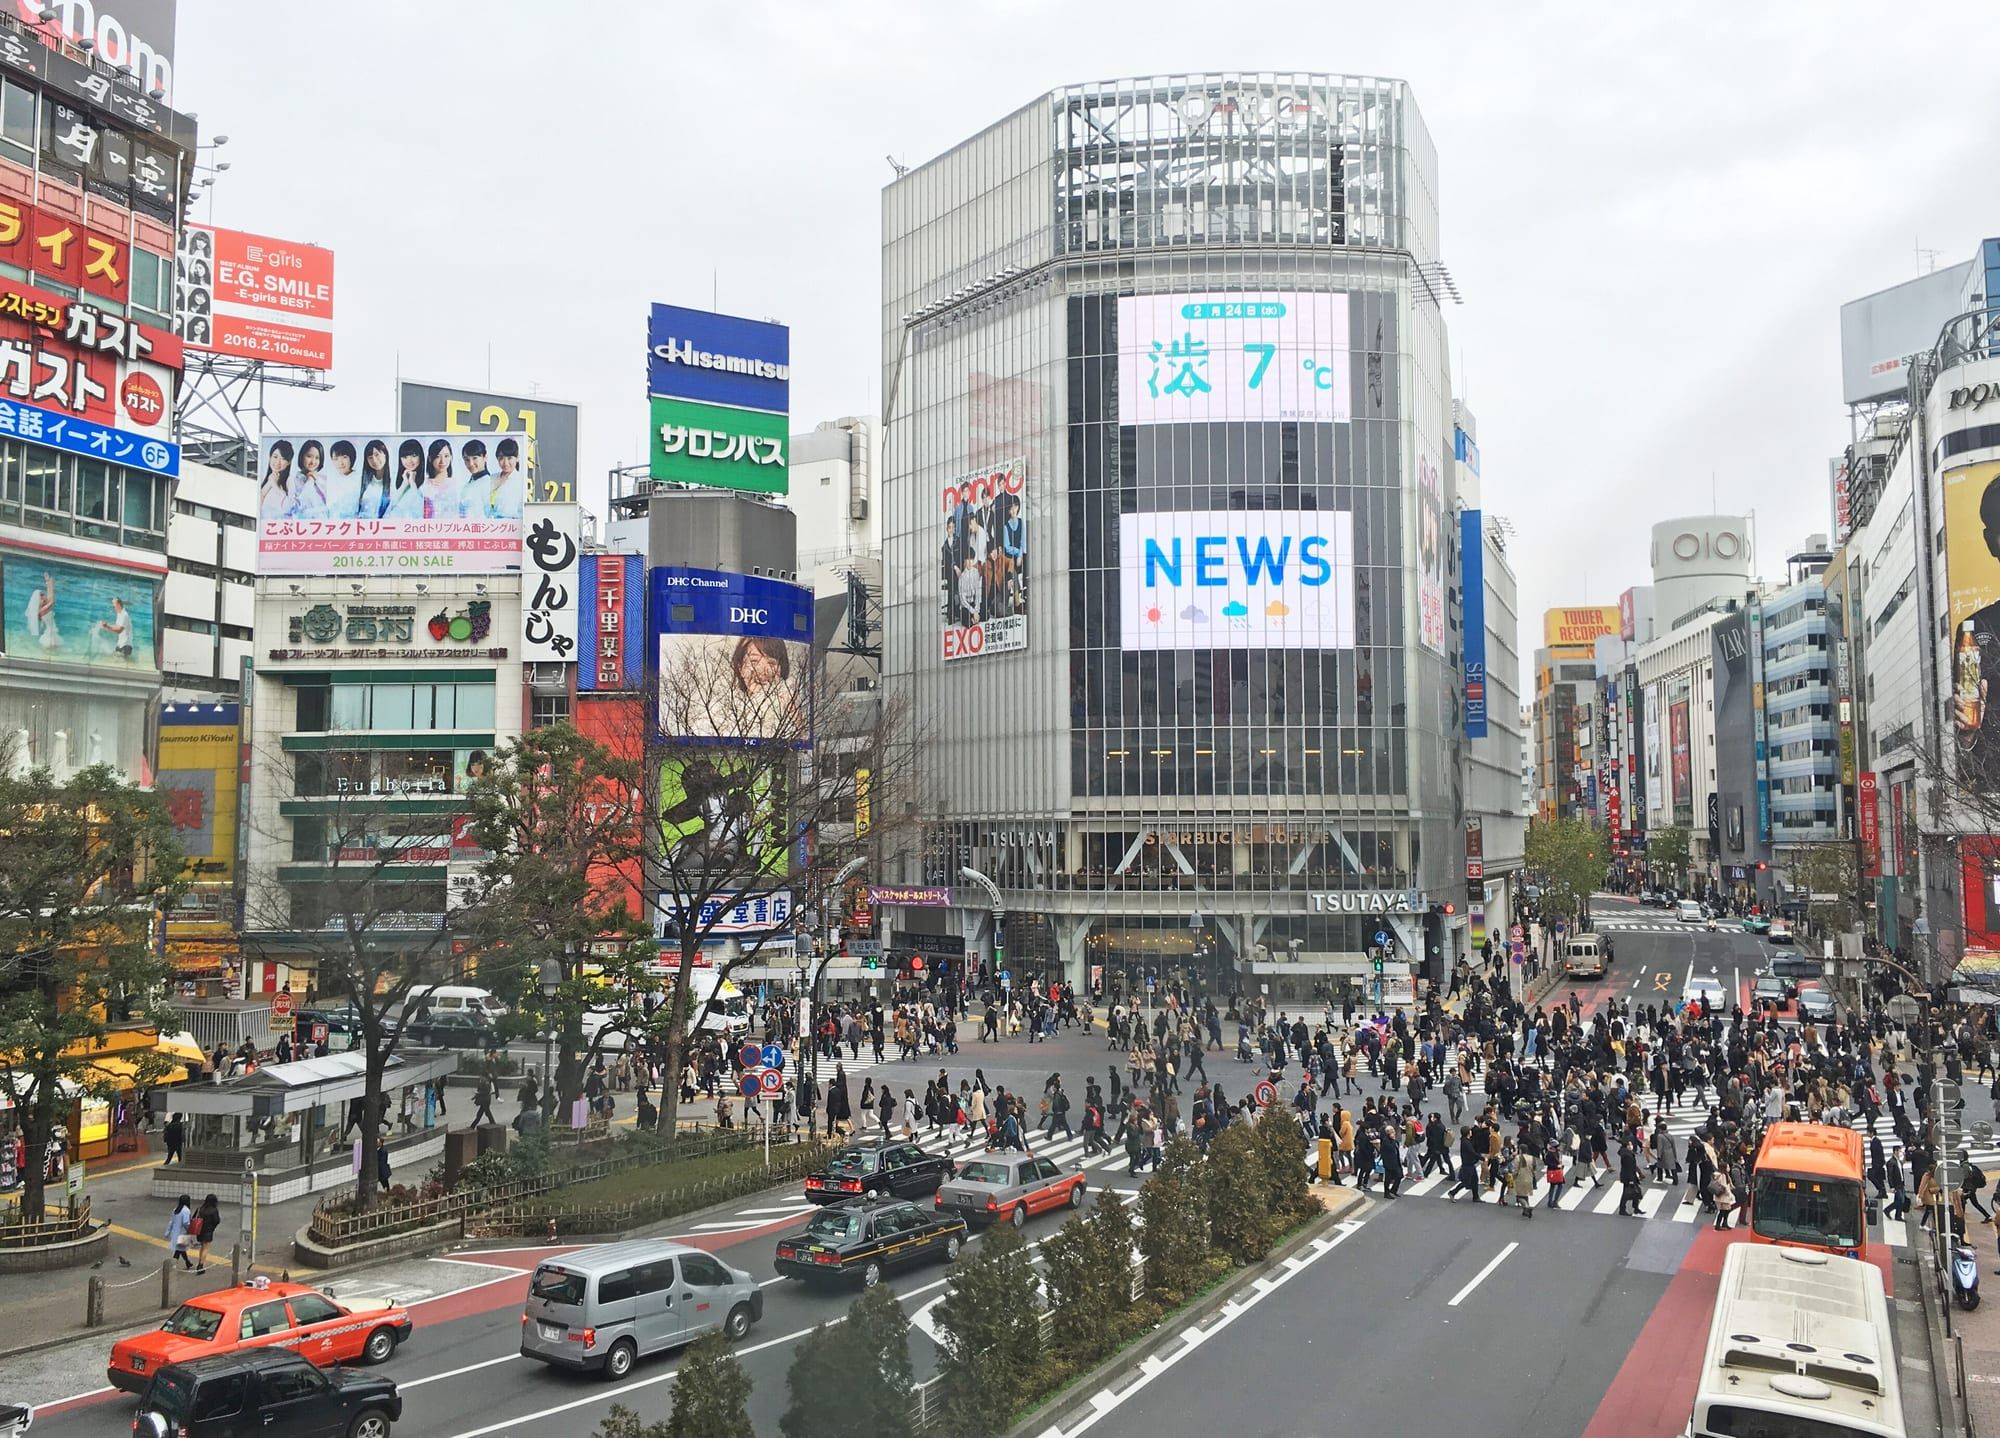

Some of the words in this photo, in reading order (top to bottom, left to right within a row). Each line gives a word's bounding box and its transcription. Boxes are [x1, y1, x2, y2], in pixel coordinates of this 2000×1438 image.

[57, 105, 75, 121] 9F
[220, 260, 237, 268] BEST
[238, 263, 260, 272] ALBUM
[247, 245, 303, 268] E-girls
[219, 266, 260, 289] E.G.
[263, 274, 330, 301] SMILE
[280, 297, 315, 310] BEST-
[66, 302, 153, 361] ガスト
[223, 333, 289, 354] 2016.2.10
[289, 348, 303, 357] ON
[303, 350, 326, 360] SALE
[654, 336, 790, 381] Hisamitsu
[1147, 332, 1212, 398] 渋
[1243, 343, 1277, 390] 7
[127, 393, 160, 413] ガスト
[146, 447, 167, 464] 6F
[660, 422, 785, 468] サロンパス
[265, 521, 397, 536] こぶしファクトリー
[332, 555, 395, 567] 2016.2.17
[398, 555, 419, 567] ON
[423, 555, 454, 567] SALE
[1145, 535, 1333, 588] NEWS
[525, 517, 577, 658] もんじゃ
[667, 577, 690, 587] DHC
[690, 577, 729, 589] Channel
[729, 607, 768, 625] DHC
[1562, 609, 1604, 625] TOWER
[345, 616, 414, 643] 西村
[944, 624, 984, 658] EXO
[1465, 662, 1485, 724] SEIBU
[337, 775, 447, 796] Euphoria
[991, 830, 1055, 848] TSUTAYA
[1144, 831, 1254, 846] STARBUCKS
[1264, 831, 1330, 845] COFFEE
[1311, 892, 1410, 913] TSUTAYA
